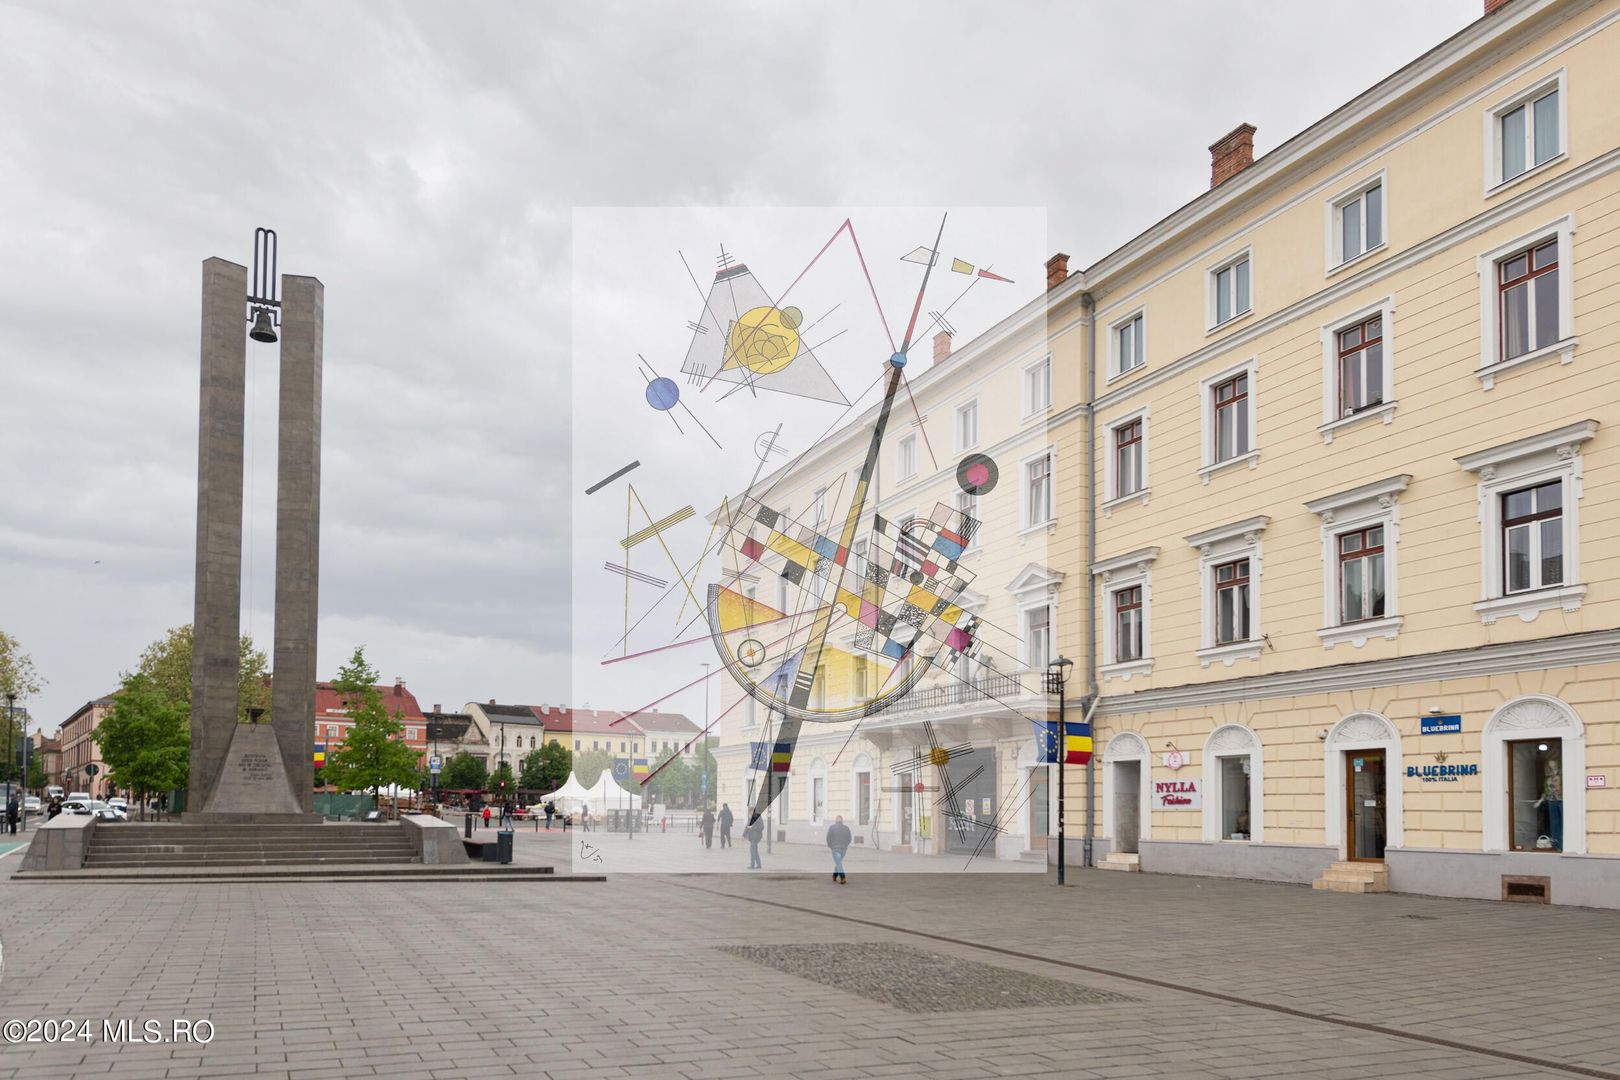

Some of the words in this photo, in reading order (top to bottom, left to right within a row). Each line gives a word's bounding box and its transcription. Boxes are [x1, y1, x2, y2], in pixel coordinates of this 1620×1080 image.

[1422, 724, 1460, 733] BLUEBRINA
[1407, 764, 1478, 777] BLUEBRINA
[1155, 781, 1197, 793] NYLLA
